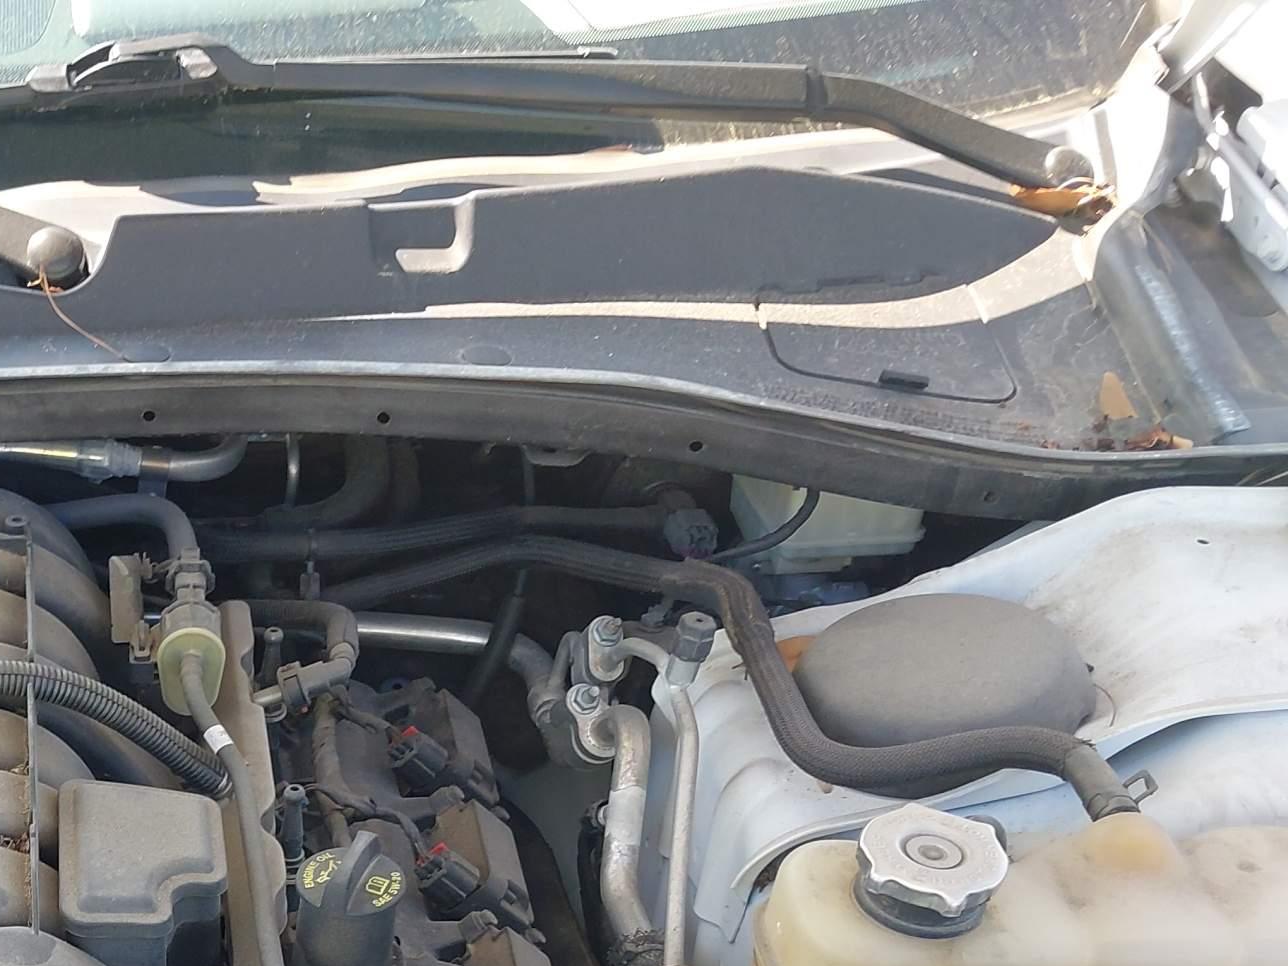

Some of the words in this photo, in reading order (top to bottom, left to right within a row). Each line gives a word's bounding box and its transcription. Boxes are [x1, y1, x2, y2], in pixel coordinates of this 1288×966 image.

[303, 861, 317, 888] ENGINE
[316, 852, 336, 863] OIL
[372, 893, 393, 907] SAE
